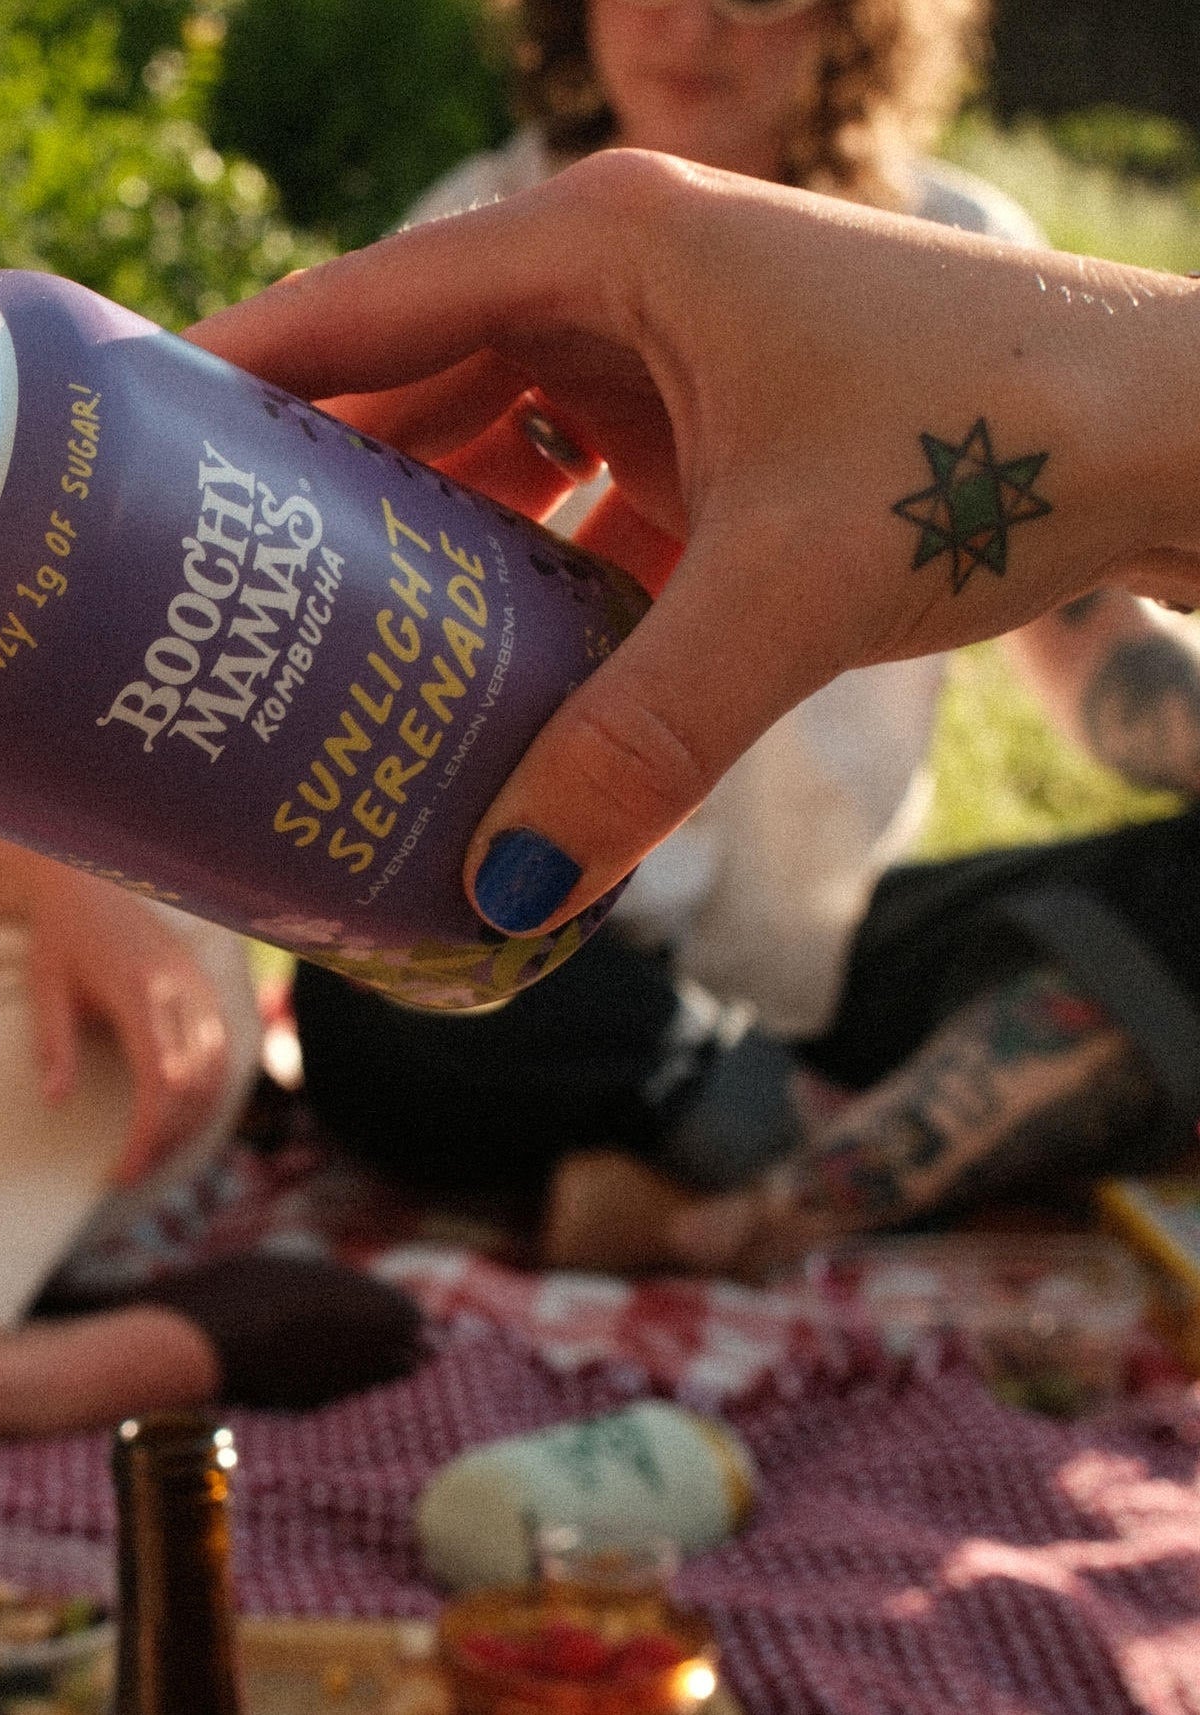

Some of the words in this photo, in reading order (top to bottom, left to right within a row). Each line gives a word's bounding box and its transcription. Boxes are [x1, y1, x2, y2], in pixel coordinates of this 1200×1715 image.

[16, 564, 68, 609] 1g
[44, 510, 78, 557] OF
[61, 383, 102, 501] SUGAR!
[166, 480, 324, 764] MAMA'S
[250, 546, 346, 743] KOMBUCHA
[273, 497, 432, 848] SUNLIGHT
[328, 530, 489, 874] SERENADE
[356, 806, 434, 905] LAVENDER
[436, 713, 488, 790] LEMON
[480, 606, 516, 708] VERBENA
